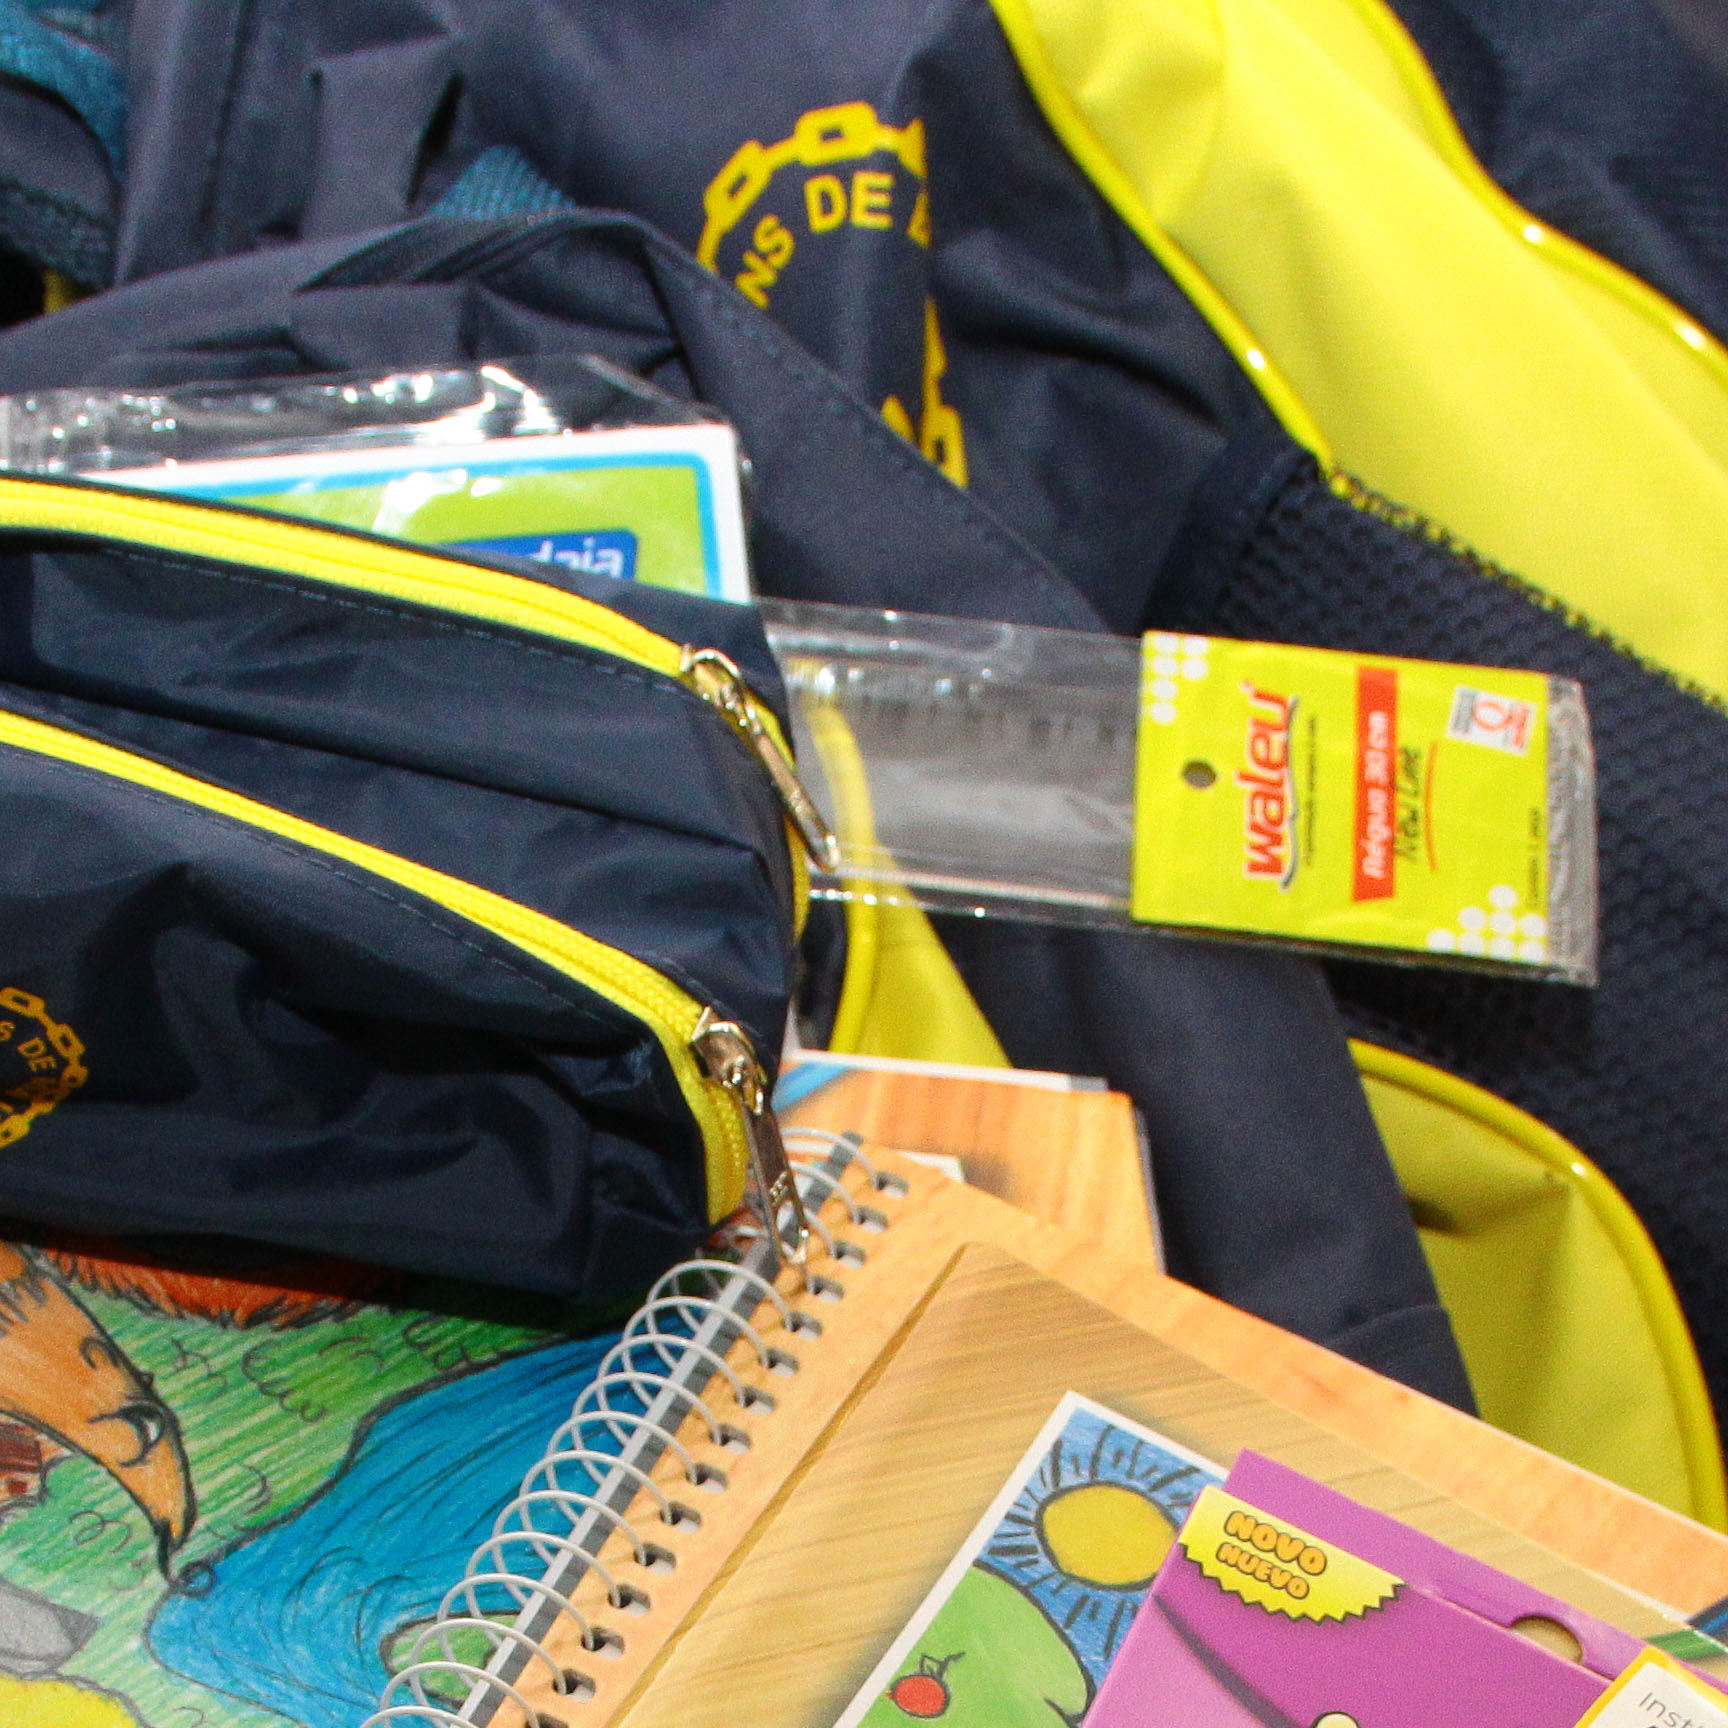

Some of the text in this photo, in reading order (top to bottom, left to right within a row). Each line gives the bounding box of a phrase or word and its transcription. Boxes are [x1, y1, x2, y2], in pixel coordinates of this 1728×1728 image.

[804, 171, 896, 233] DE
[1236, 689, 1290, 877] waleu
[17, 1037, 56, 1072] DE
[1216, 1542, 1310, 1599] NUEVO
[1224, 1511, 1327, 1575] NOVO
